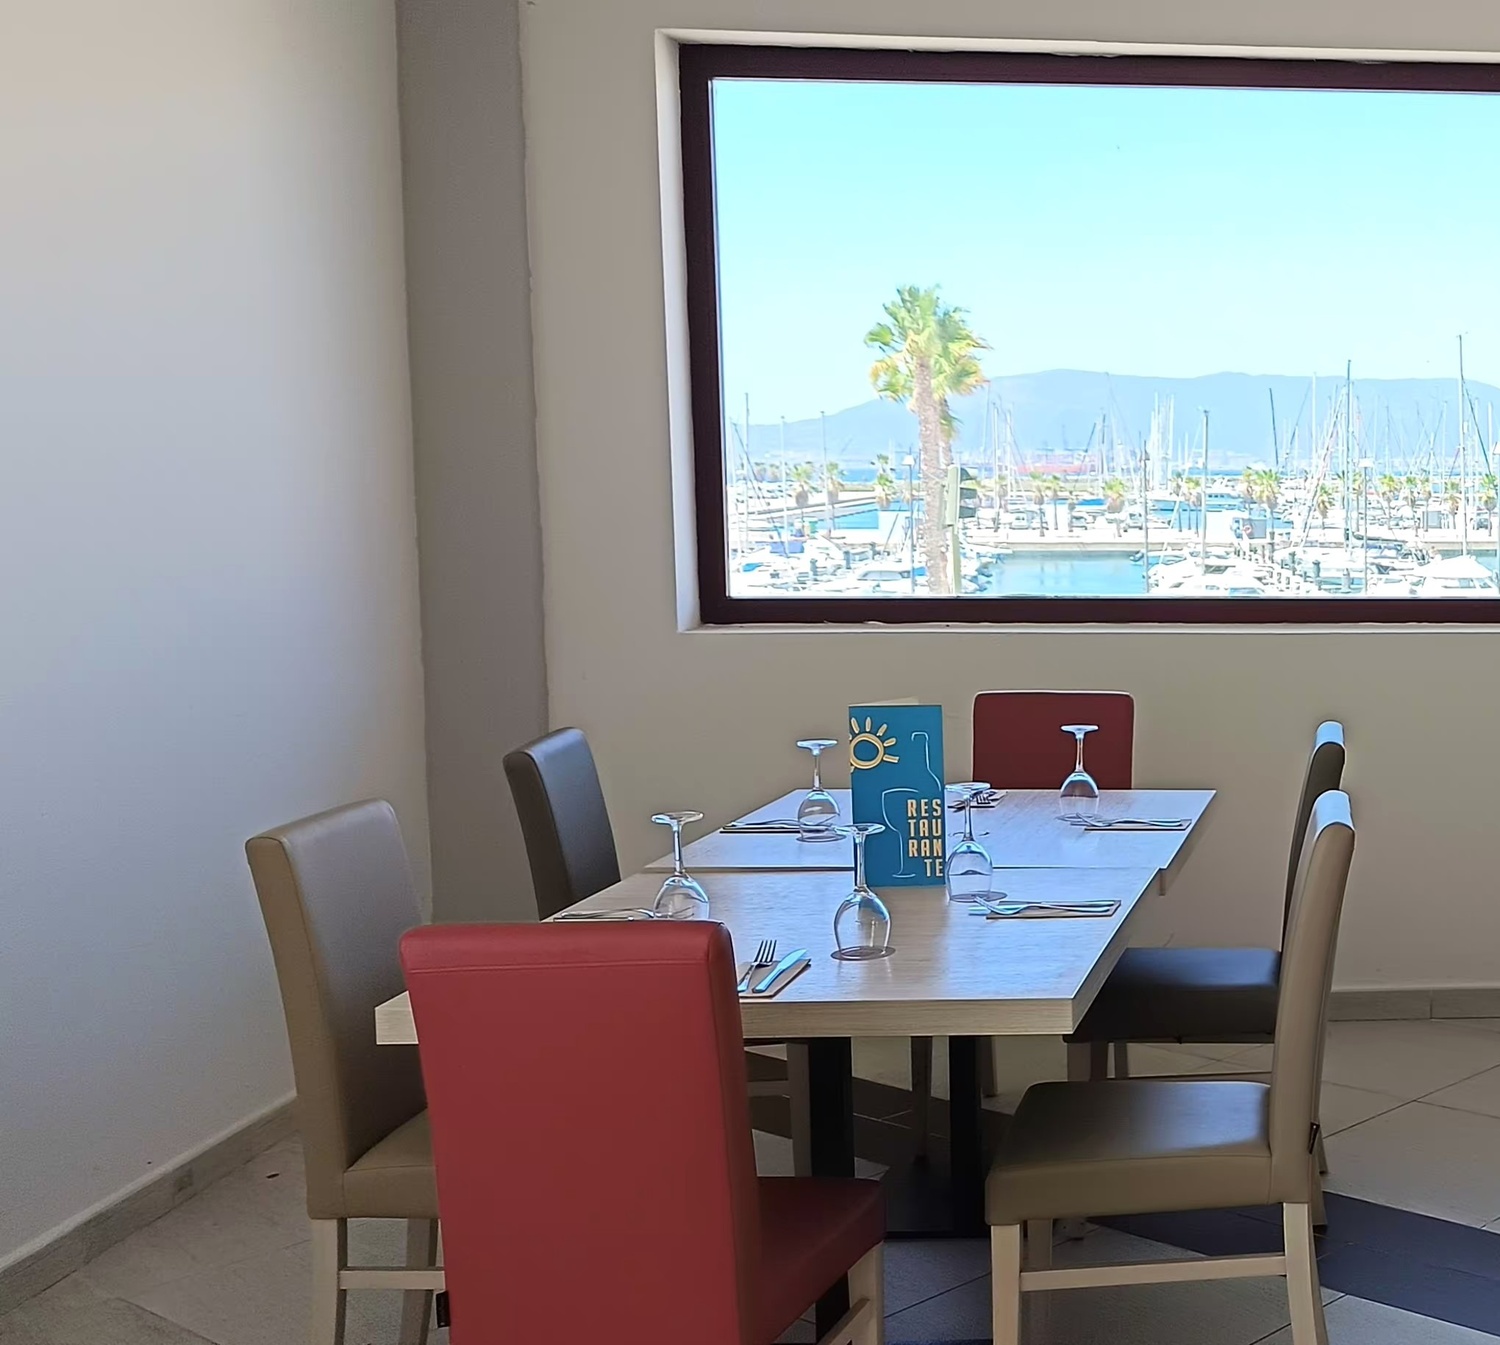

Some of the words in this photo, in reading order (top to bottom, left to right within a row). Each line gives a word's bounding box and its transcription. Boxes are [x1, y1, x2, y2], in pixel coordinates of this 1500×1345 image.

[907, 799, 942, 817] RES
[908, 819, 942, 837] TAU
[908, 839, 943, 857] RAN
[924, 859, 944, 877] TE
